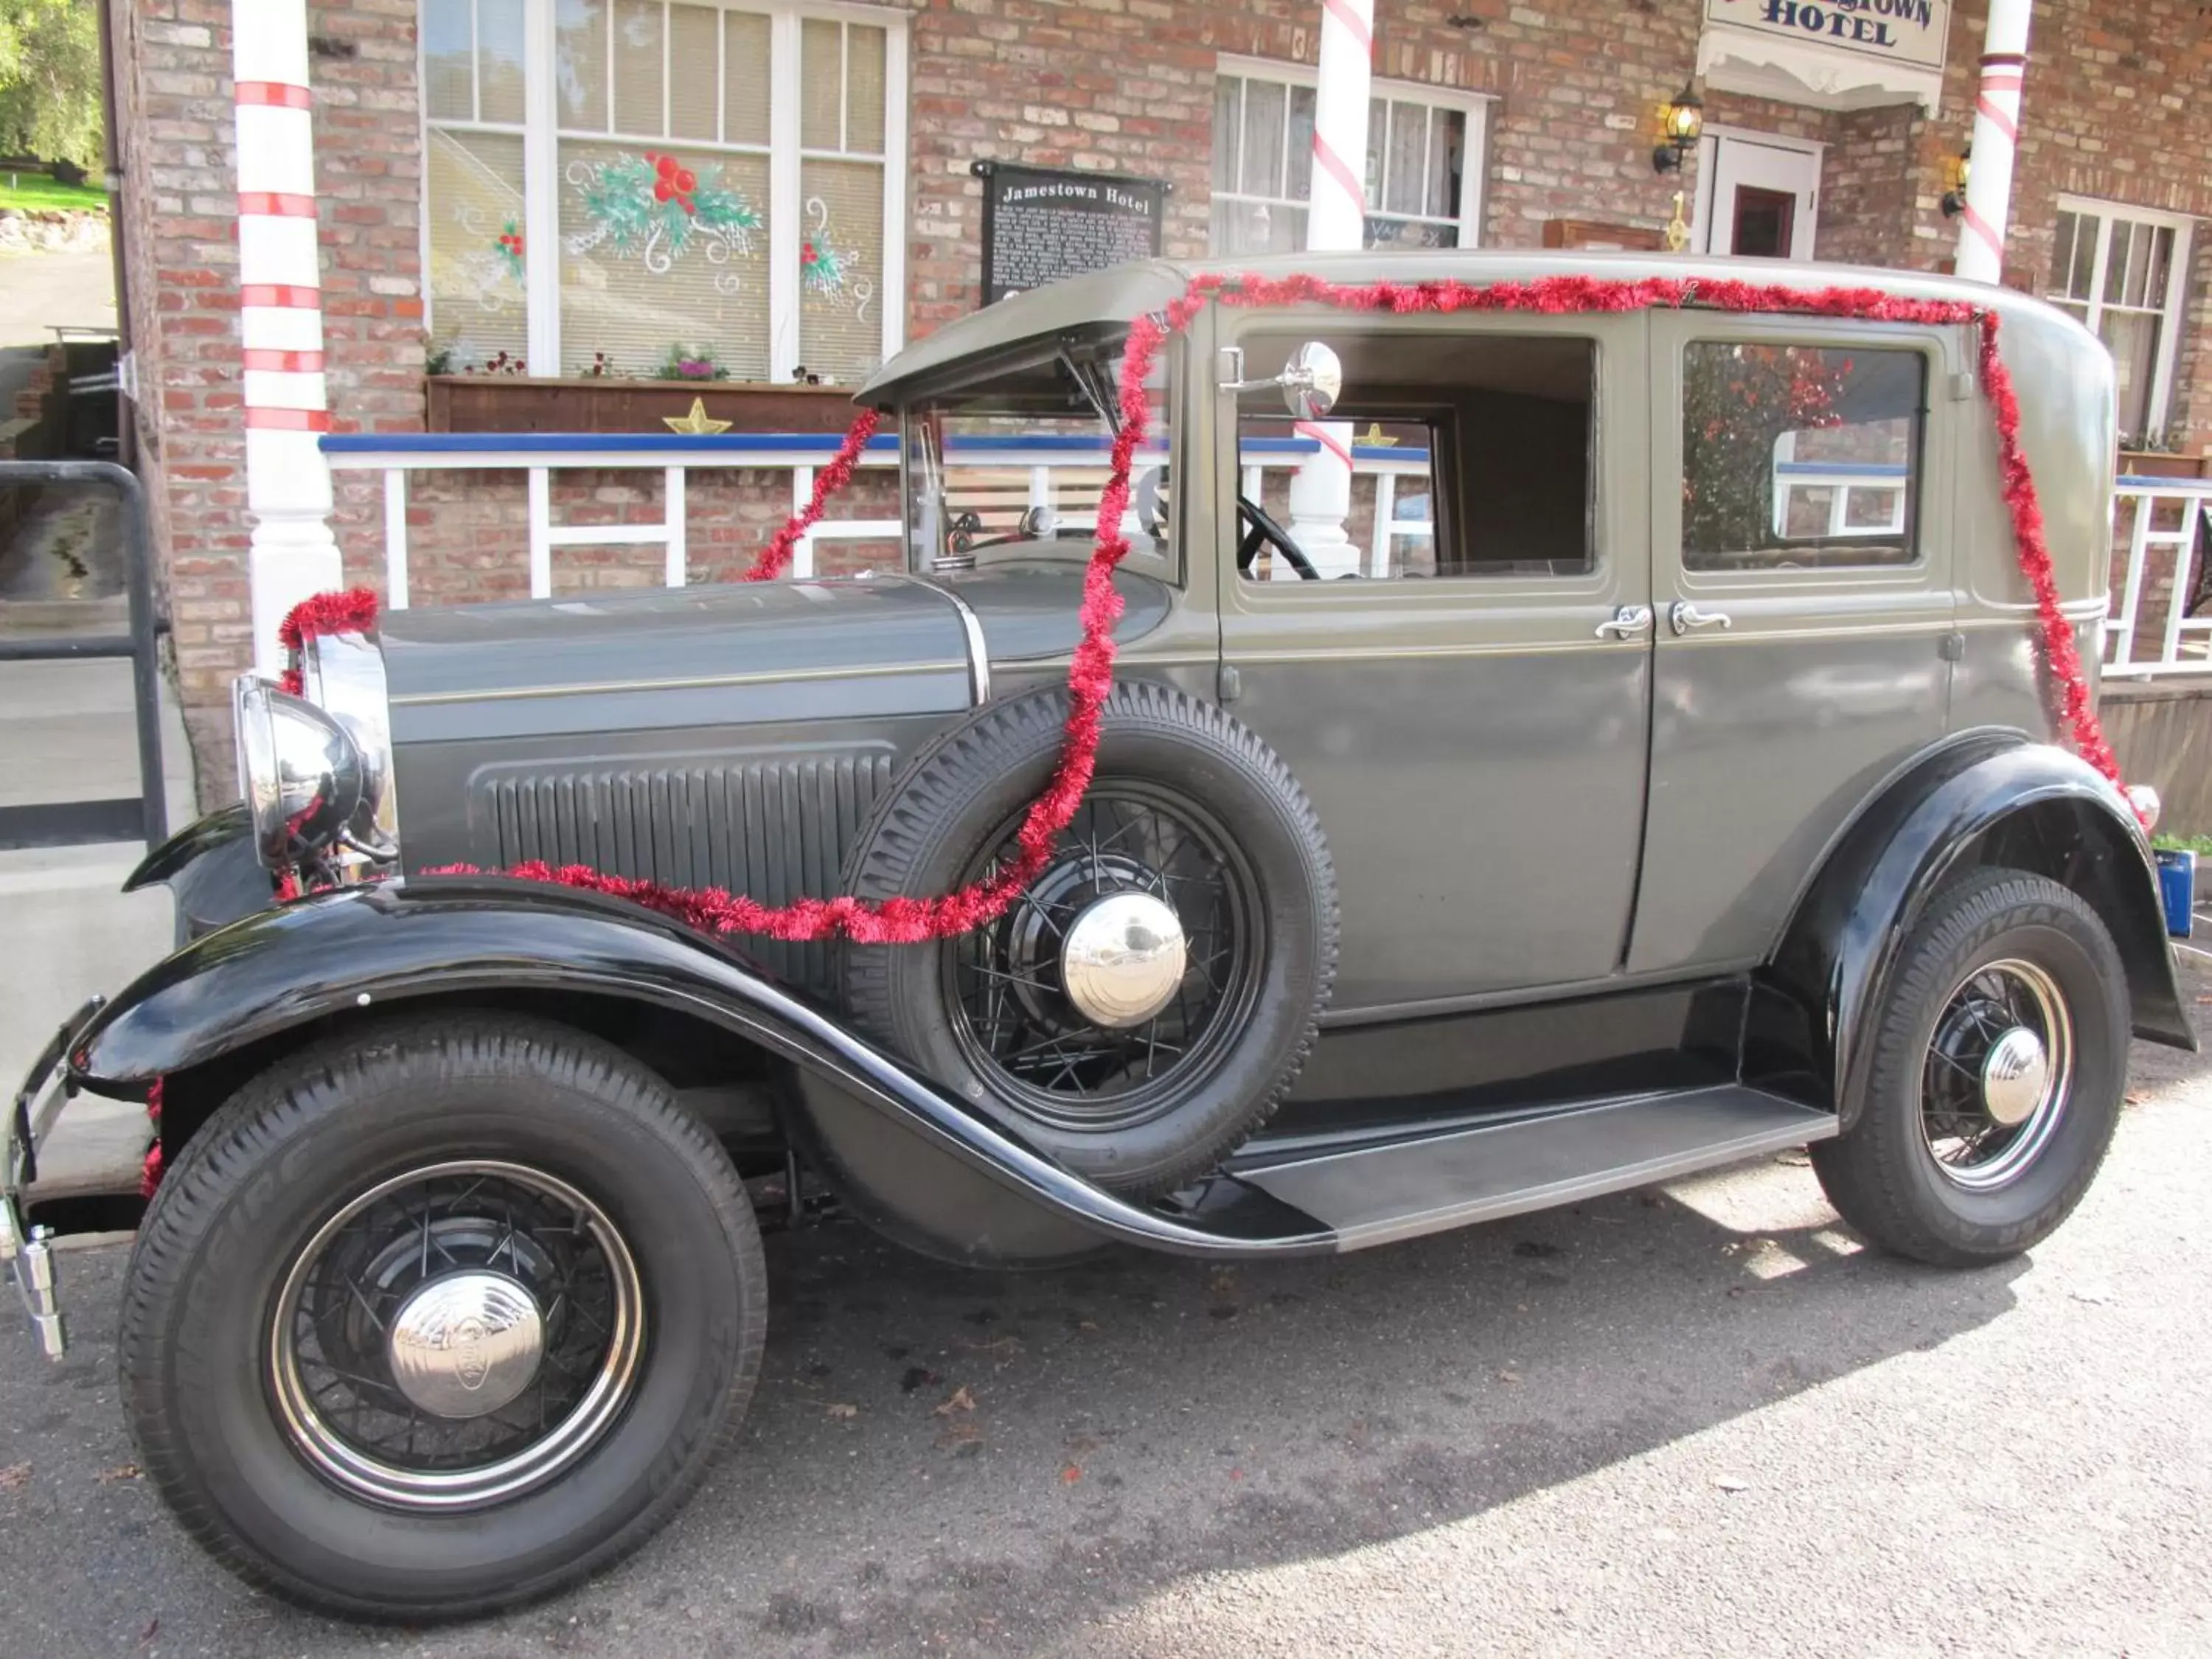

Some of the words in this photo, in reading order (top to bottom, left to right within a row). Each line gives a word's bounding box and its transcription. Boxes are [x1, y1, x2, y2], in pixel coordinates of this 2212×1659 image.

[1759, 0, 1897, 47] HOTEL
[1004, 184, 1097, 202] Jamestown
[1106, 187, 1149, 215] Hotel
